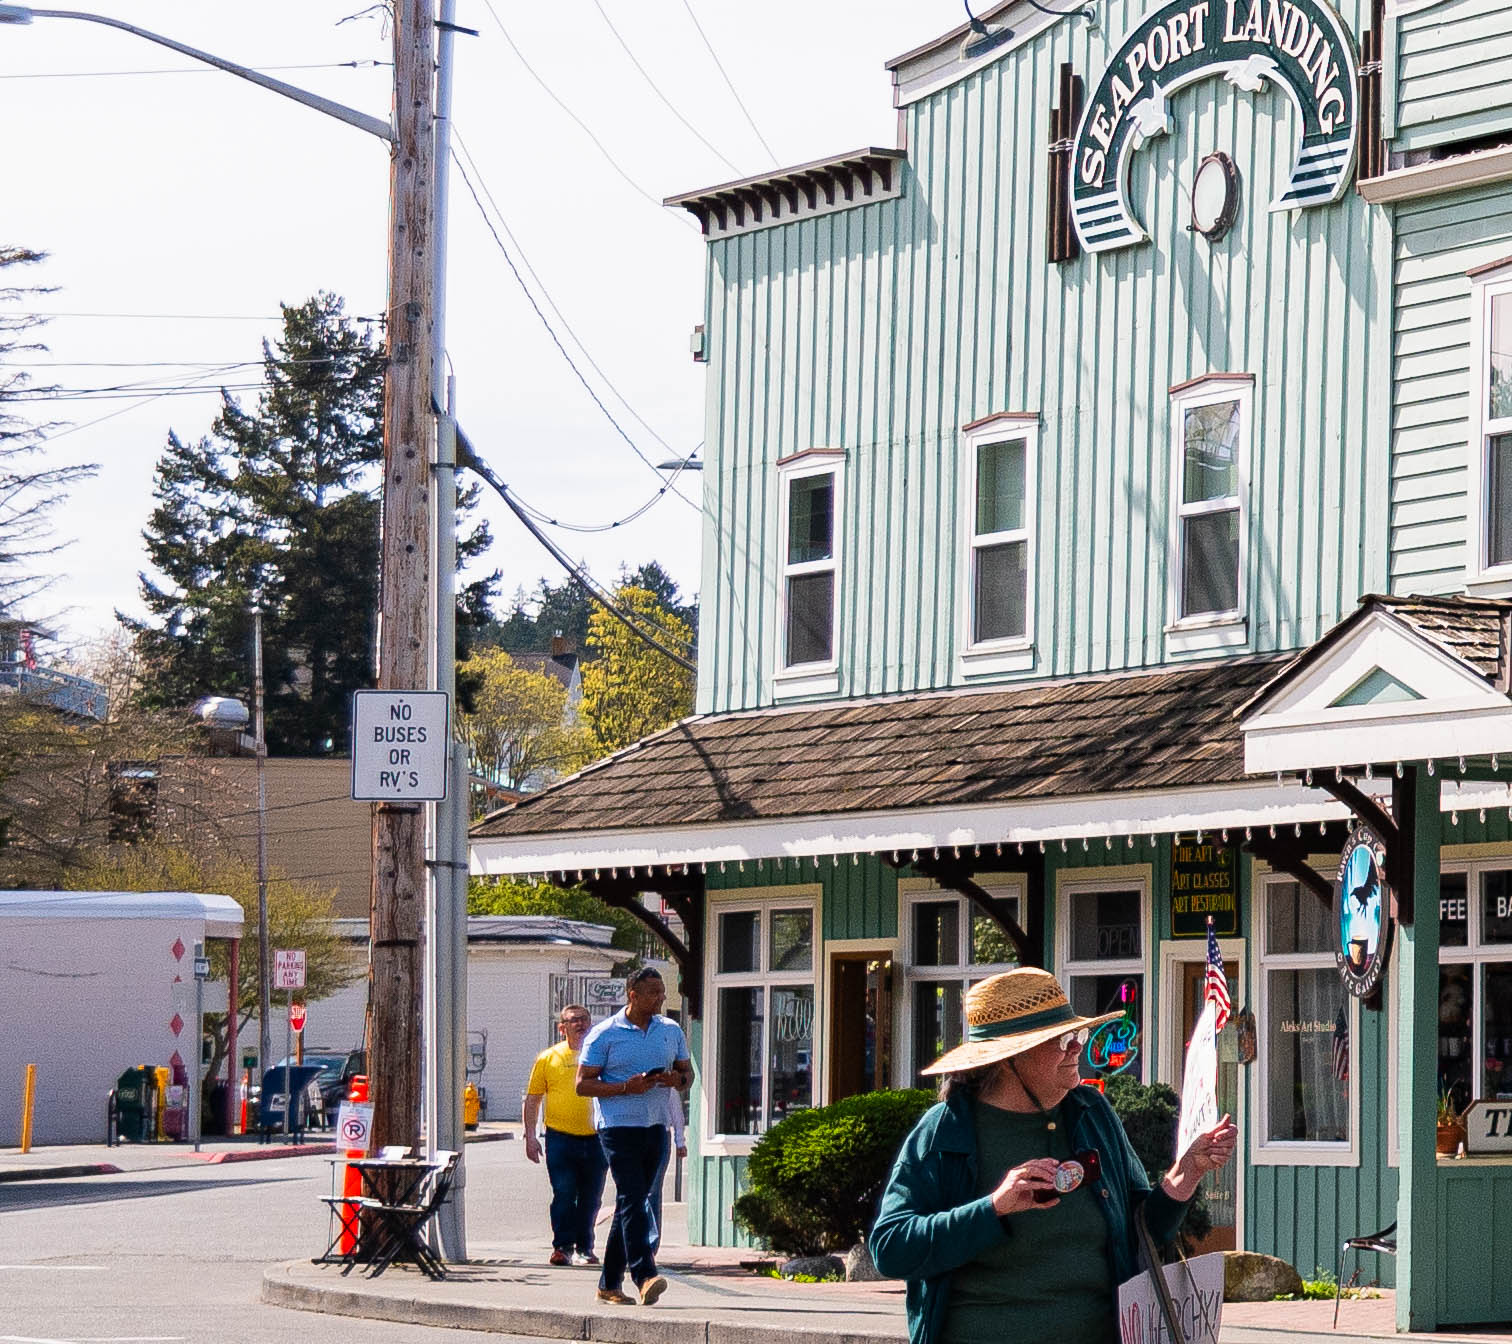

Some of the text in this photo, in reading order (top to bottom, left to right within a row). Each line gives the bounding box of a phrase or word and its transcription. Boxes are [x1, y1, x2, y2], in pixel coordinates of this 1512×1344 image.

[1081, 2, 1209, 188] SEAPORT
[391, 704, 412, 720] NO
[374, 726, 427, 742] BUSES
[389, 749, 410, 765] OR
[380, 771, 418, 787] RV'S
